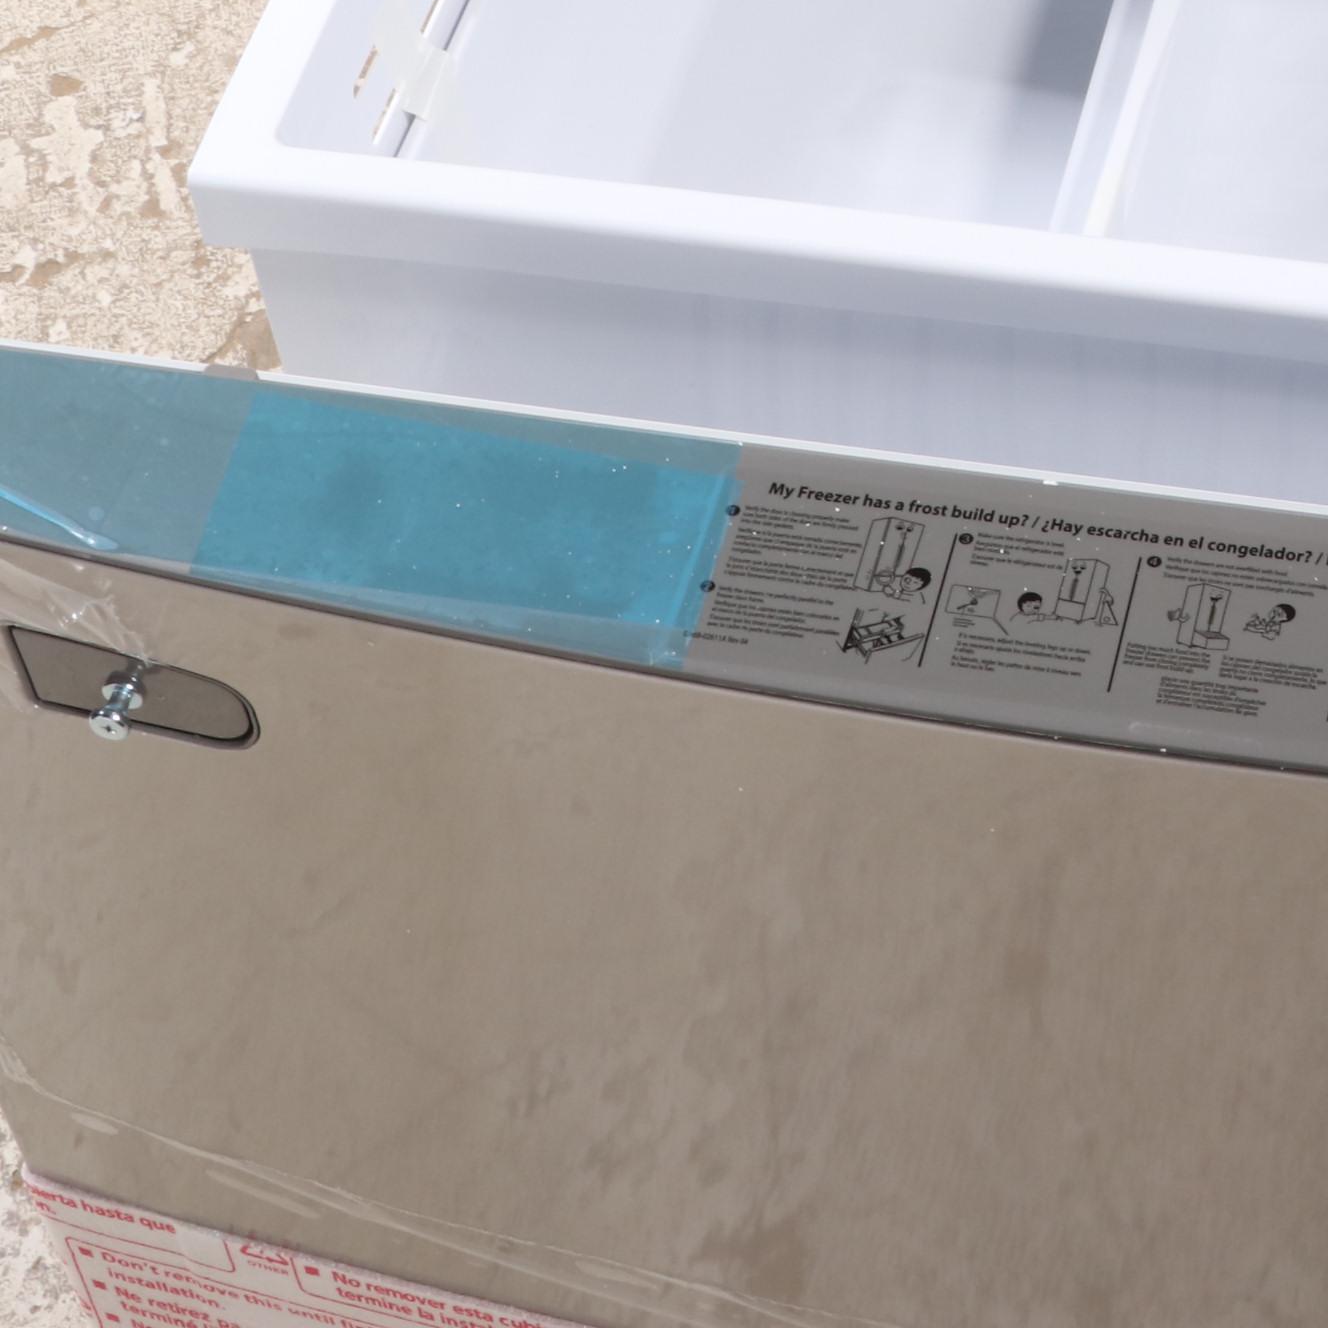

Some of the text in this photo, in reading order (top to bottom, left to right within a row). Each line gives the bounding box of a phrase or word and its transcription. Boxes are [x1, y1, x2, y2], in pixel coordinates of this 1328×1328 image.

[767, 481, 795, 501] My
[796, 485, 860, 505] Freezer
[862, 493, 892, 509] has
[894, 499, 905, 511] a
[907, 499, 949, 516] frost
[950, 504, 995, 522] build
[997, 512, 1029, 528] up?
[1041, 515, 1084, 536] ¿Hay
[1086, 523, 1160, 542] escarcha
[1162, 533, 1185, 545] en
[1187, 535, 1204, 548] el
[1206, 538, 1313, 562] congelador?
[80, 1200, 135, 1223] hasta
[139, 1217, 176, 1234] que
[101, 1251, 160, 1275] Don't
[164, 1270, 240, 1299] remove
[244, 1293, 282, 1312] this
[108, 1268, 226, 1310] installation.
[331, 1271, 360, 1288] No
[366, 1283, 447, 1310] remover
[453, 1305, 494, 1322] esta
[114, 1286, 142, 1303] Ne
[148, 1297, 210, 1321] retirez
[336, 1287, 413, 1315] termine
[417, 1306, 435, 1321] la
